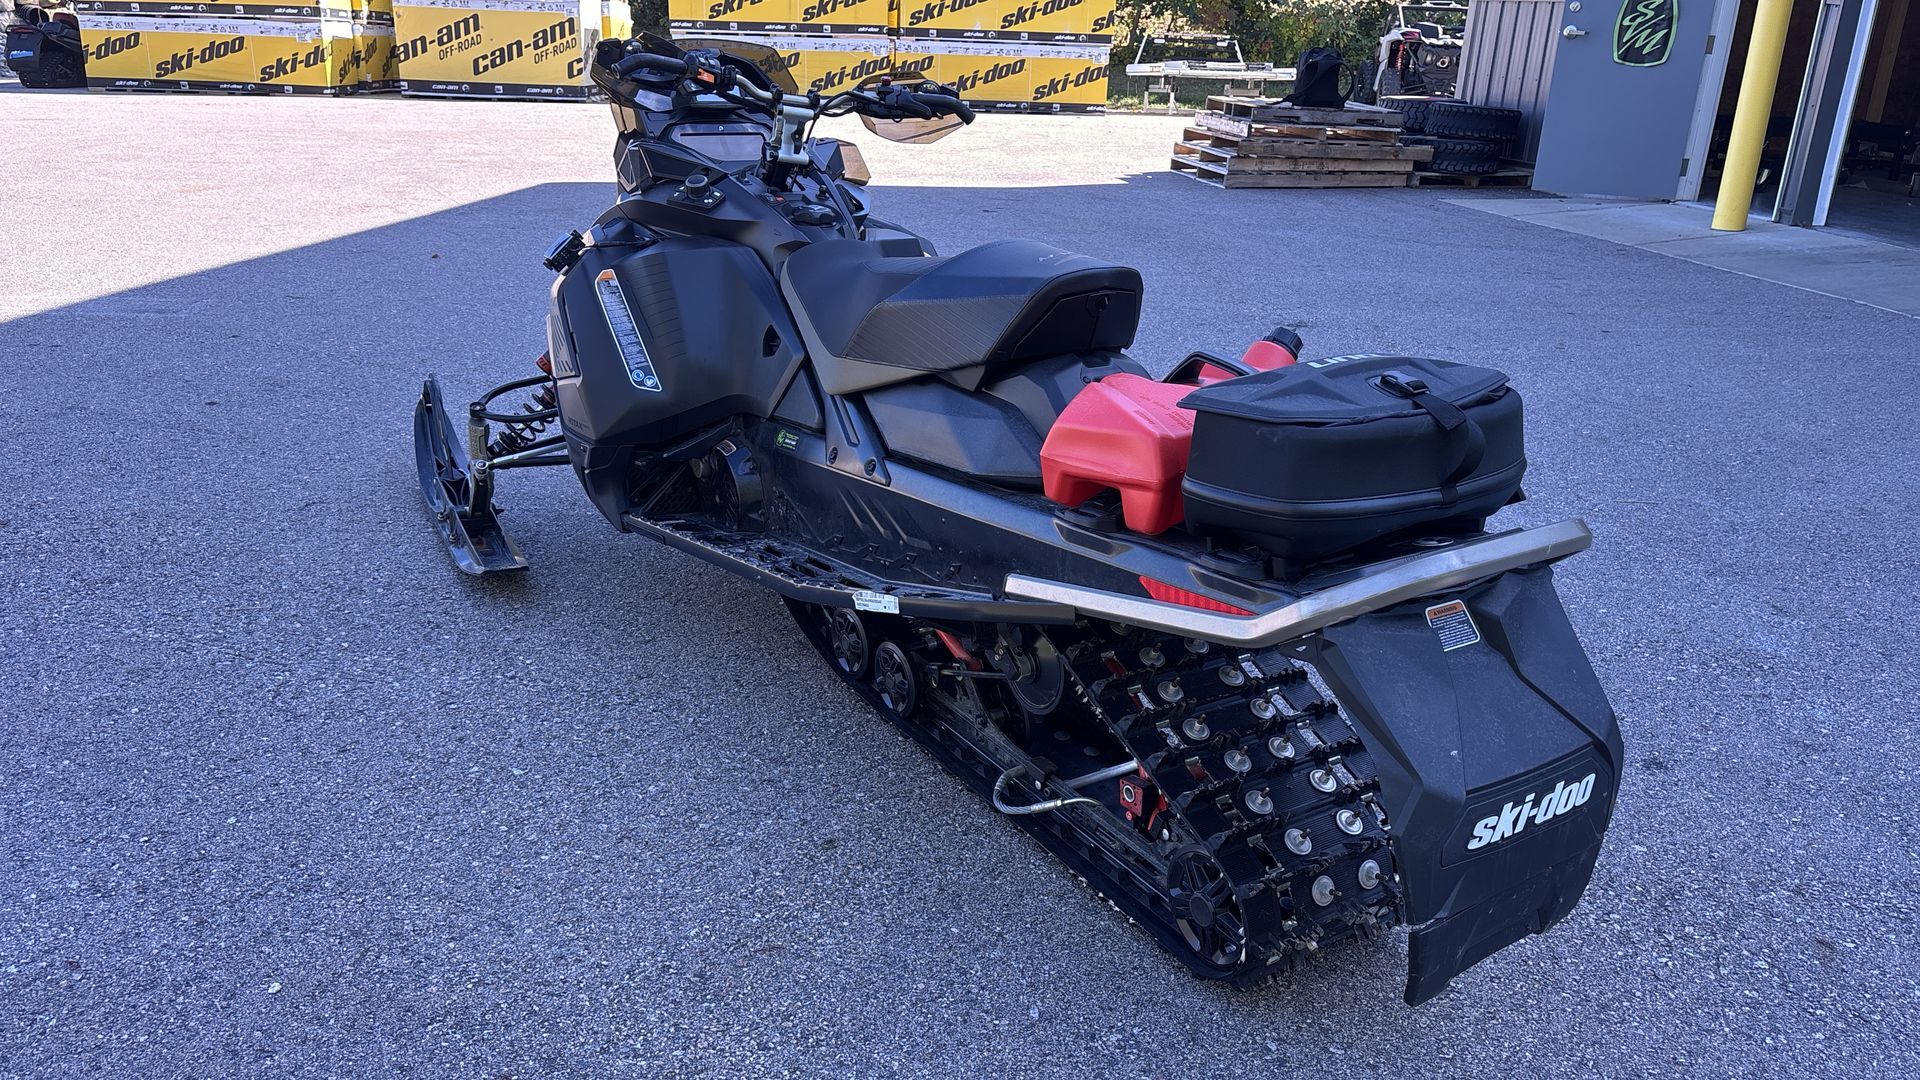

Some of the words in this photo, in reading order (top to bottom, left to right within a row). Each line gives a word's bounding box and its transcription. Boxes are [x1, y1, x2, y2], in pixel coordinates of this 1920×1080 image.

[155, 36, 245, 79] ski-doo
[439, 33, 482, 61] OFF-ROAD
[472, 17, 576, 76] can-am
[533, 37, 577, 64] OFF-ROAD
[1466, 773, 1597, 850] ski-doo
